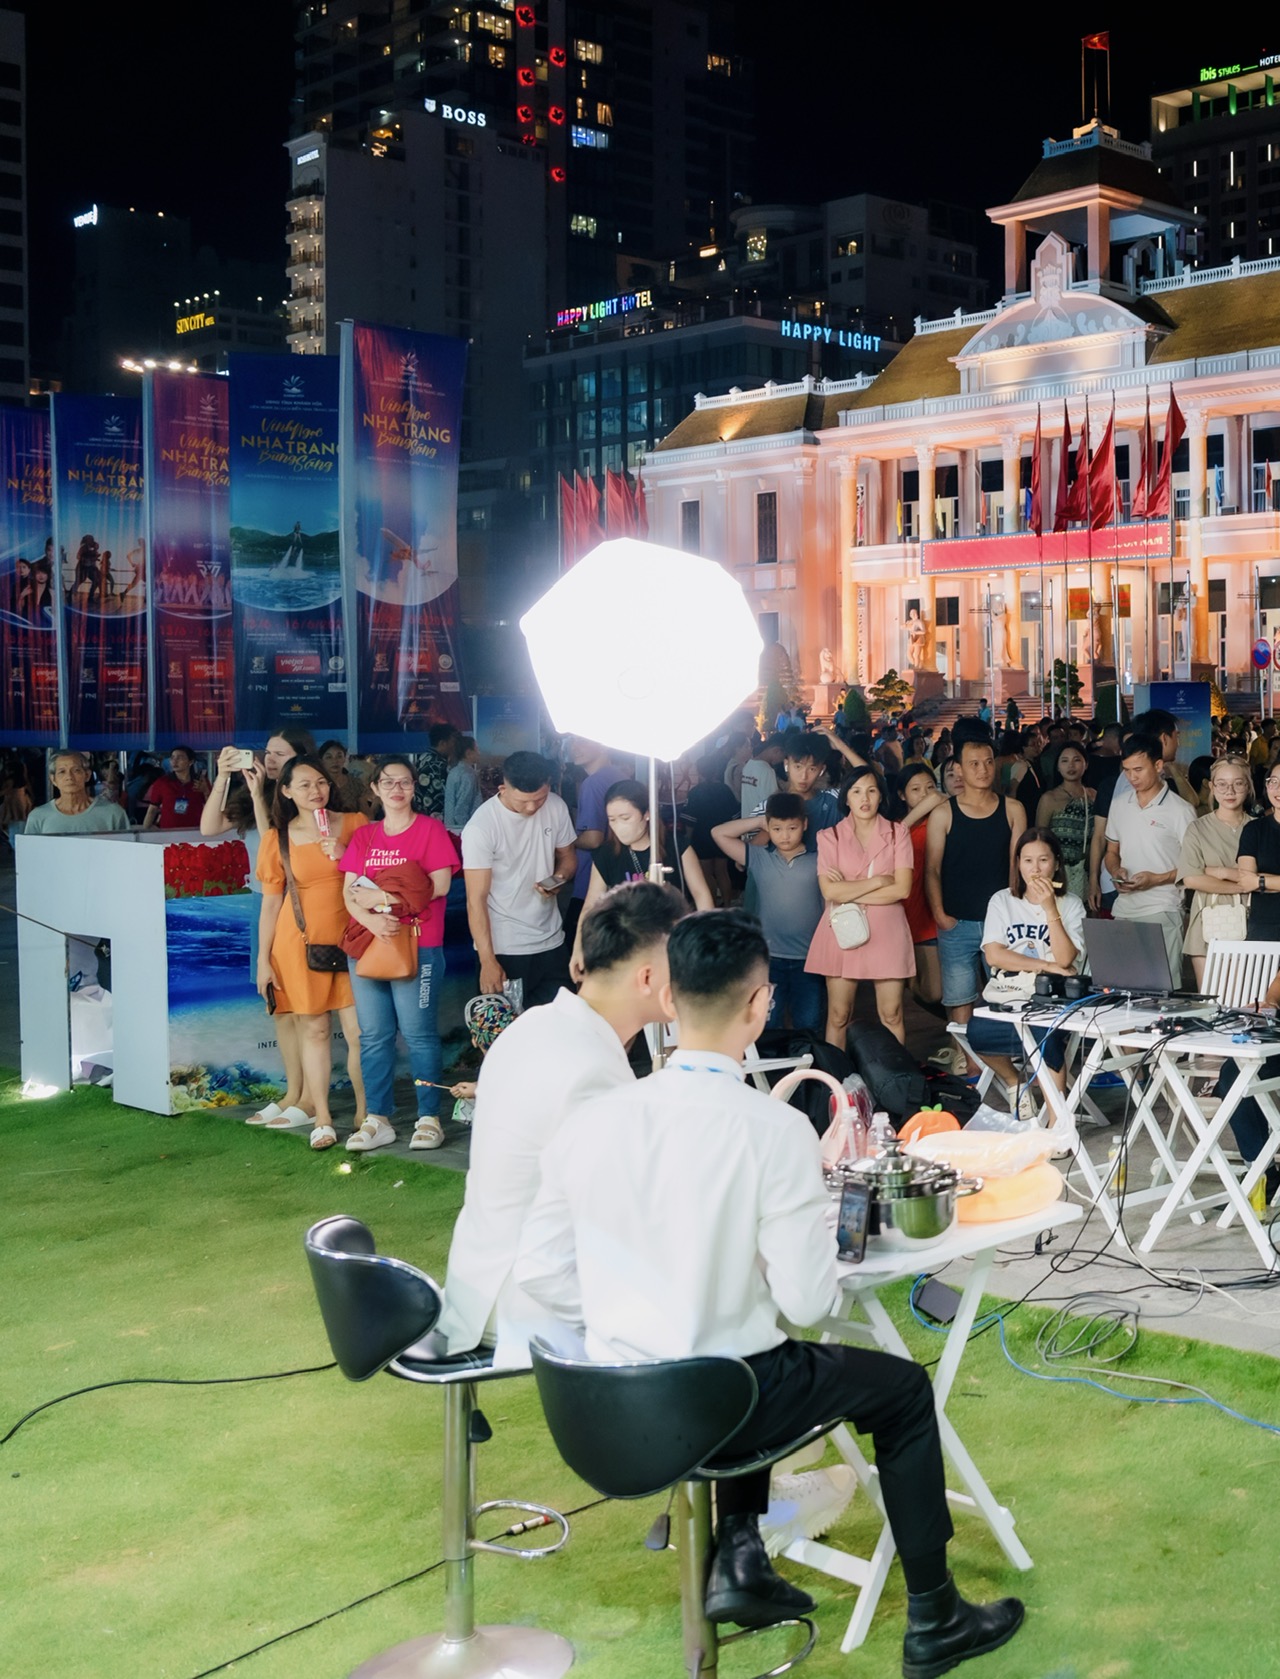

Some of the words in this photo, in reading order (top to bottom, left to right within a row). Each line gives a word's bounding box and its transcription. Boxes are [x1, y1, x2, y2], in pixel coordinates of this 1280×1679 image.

[1200, 67, 1217, 82] ibis
[442, 104, 487, 127] BOSS
[556, 305, 589, 327] HAPPY
[588, 298, 618, 320] LIGHT
[621, 289, 653, 312] HOTEL
[176, 317, 190, 335] SUN
[189, 312, 206, 331] CITY
[781, 319, 832, 344] HAPPY
[839, 329, 881, 353] LIGHT
[362, 413, 399, 432] NHA
[401, 421, 451, 444] TRANG
[241, 435, 284, 450] NHA
[161, 448, 199, 465] NHA
[67, 469, 105, 482] NHA
[7, 478, 44, 493] NHA
[371, 848, 401, 857] Trust
[421, 963, 432, 979] KARL
[419, 978, 432, 1009] LAGERFELD
